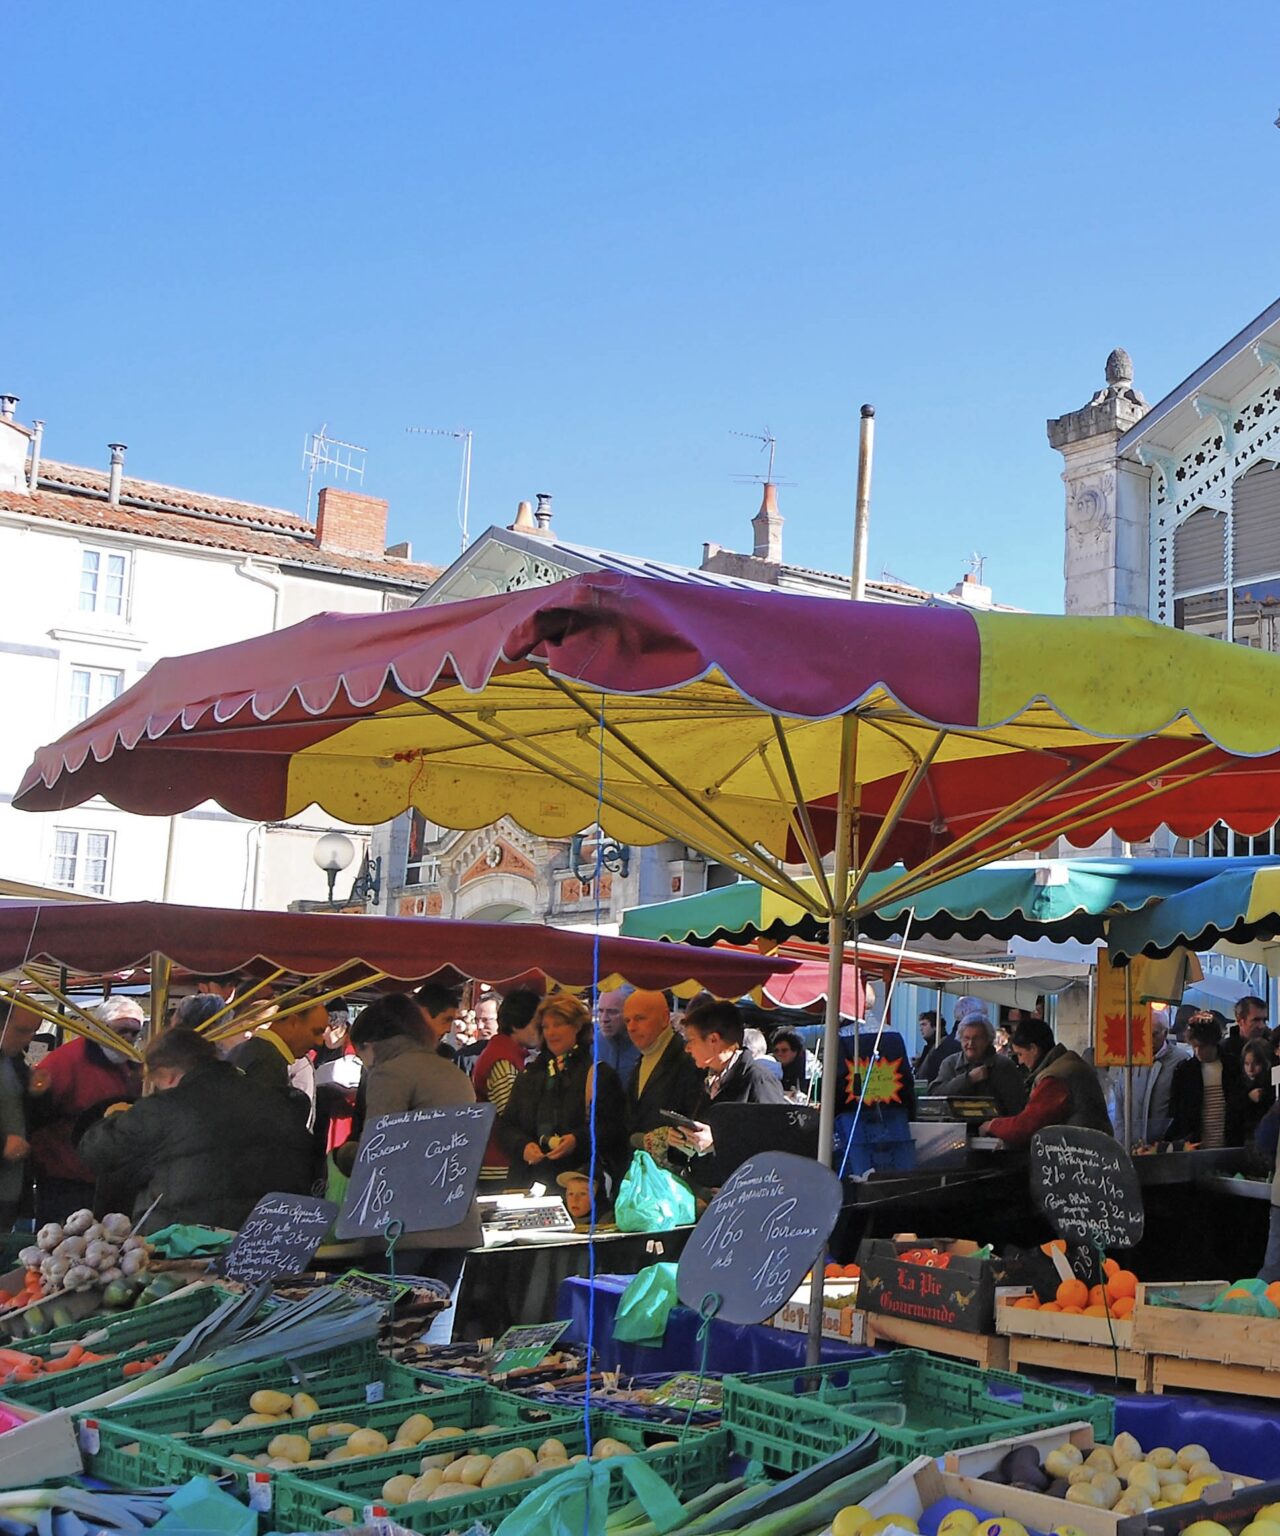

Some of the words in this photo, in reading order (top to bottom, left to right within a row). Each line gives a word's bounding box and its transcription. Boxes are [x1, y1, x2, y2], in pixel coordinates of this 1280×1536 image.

[760, 1198, 819, 1242] Poireaux
[897, 1267, 916, 1291] La
[920, 1271, 943, 1298] Pie
[879, 1291, 957, 1323] Gourmande
